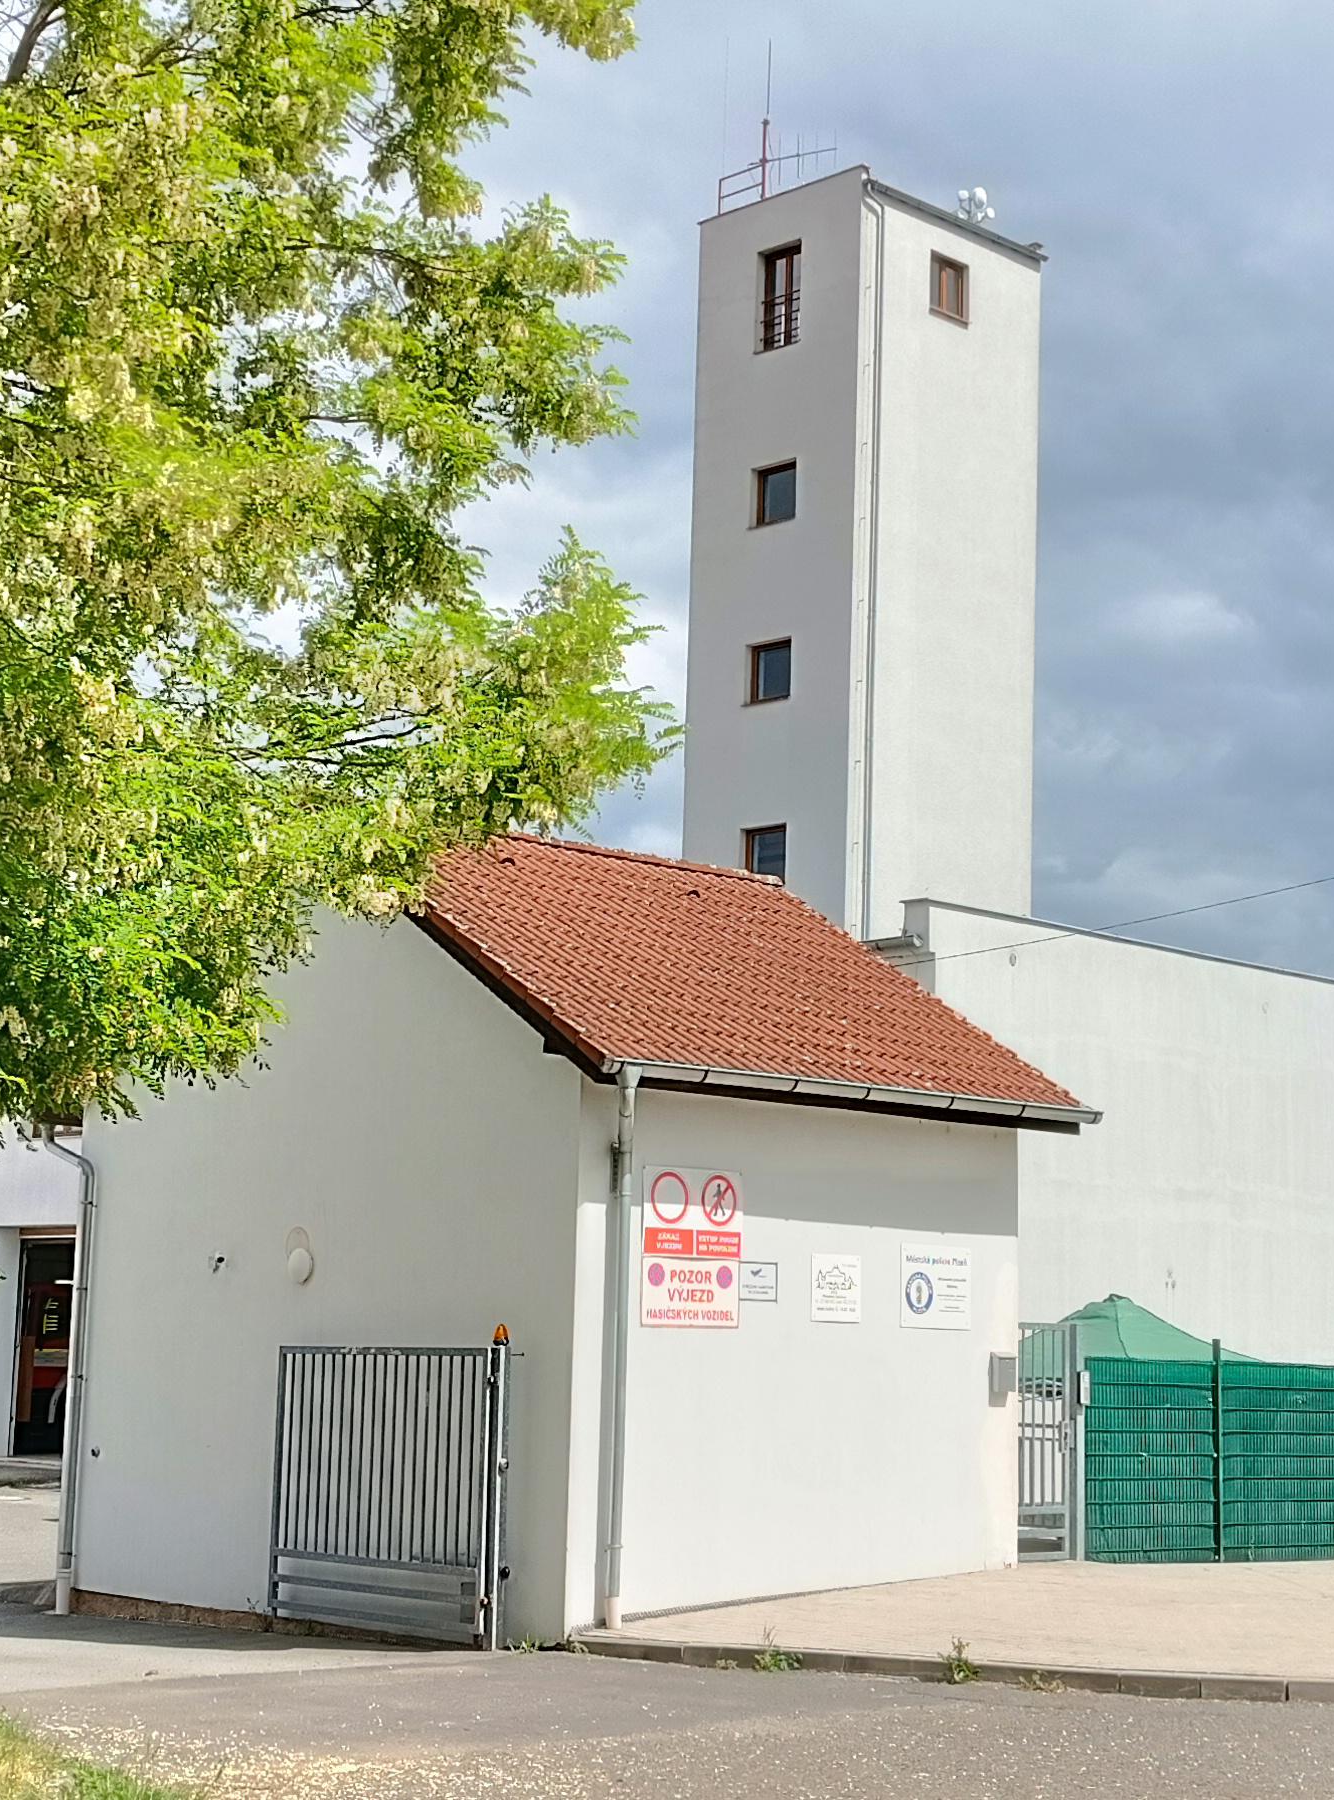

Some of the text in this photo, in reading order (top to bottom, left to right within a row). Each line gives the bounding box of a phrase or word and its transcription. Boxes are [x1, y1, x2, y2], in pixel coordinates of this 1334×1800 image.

[670, 1269, 712, 1284] POZOR
[668, 1284, 714, 1303] VÝJEZD
[647, 1306, 734, 1322] HASIČSKÝCH VOZIDEL
